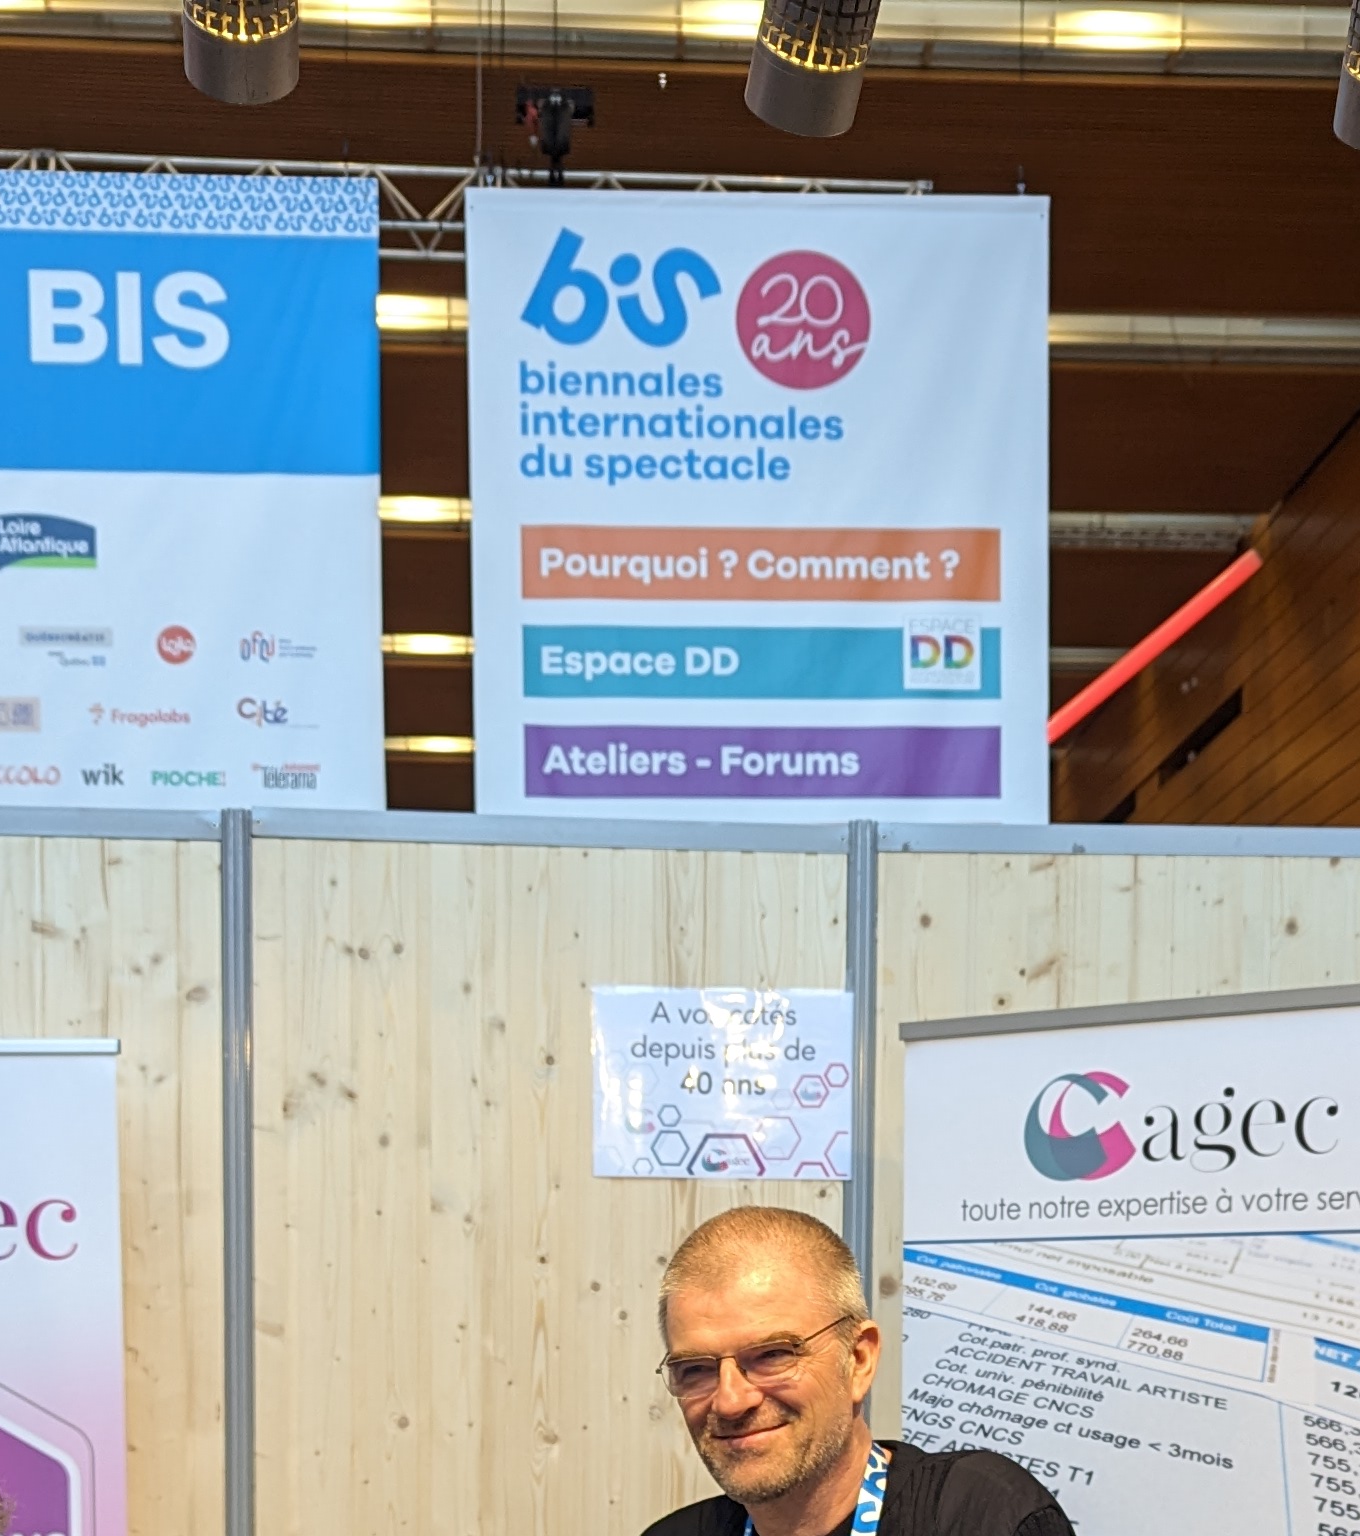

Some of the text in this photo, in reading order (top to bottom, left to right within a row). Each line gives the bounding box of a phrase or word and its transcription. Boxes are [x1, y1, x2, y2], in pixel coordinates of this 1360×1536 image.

[756, 273, 845, 326] 20
[26, 268, 231, 370] BIS
[750, 327, 870, 367] ans
[519, 362, 723, 397] biennales
[519, 402, 844, 440] internationales
[519, 444, 791, 485] du spectacle
[539, 548, 960, 584] Pourquoi ? Comment ?
[540, 646, 739, 681] Espace DD
[910, 635, 975, 669] DD
[82, 763, 124, 786] wik
[543, 743, 860, 776] Ateliers Forums
[651, 1001, 670, 1023] A
[631, 1035, 715, 1066] depuis
[784, 1037, 816, 1061] de
[681, 1072, 766, 1095] 40 ans
[961, 1194, 1021, 1223] toute
[1028, 1194, 1089, 1221] notre
[1097, 1189, 1209, 1227] expertise
[1216, 1186, 1233, 1214] à
[1241, 1187, 1309, 1213] votre
[945, 1344, 1228, 1410] ACCIDENT TRAVAIL ARTISTE
[1031, 1347, 1120, 1374] prof. synd.
[922, 1372, 1095, 1419] CHOMAGE CNCS
[935, 1358, 1104, 1403] Cot. univ. pénibilité
[908, 1388, 1234, 1469] Majo chômage ct usage 3mois
[959, 1421, 1024, 1445] CNCS
